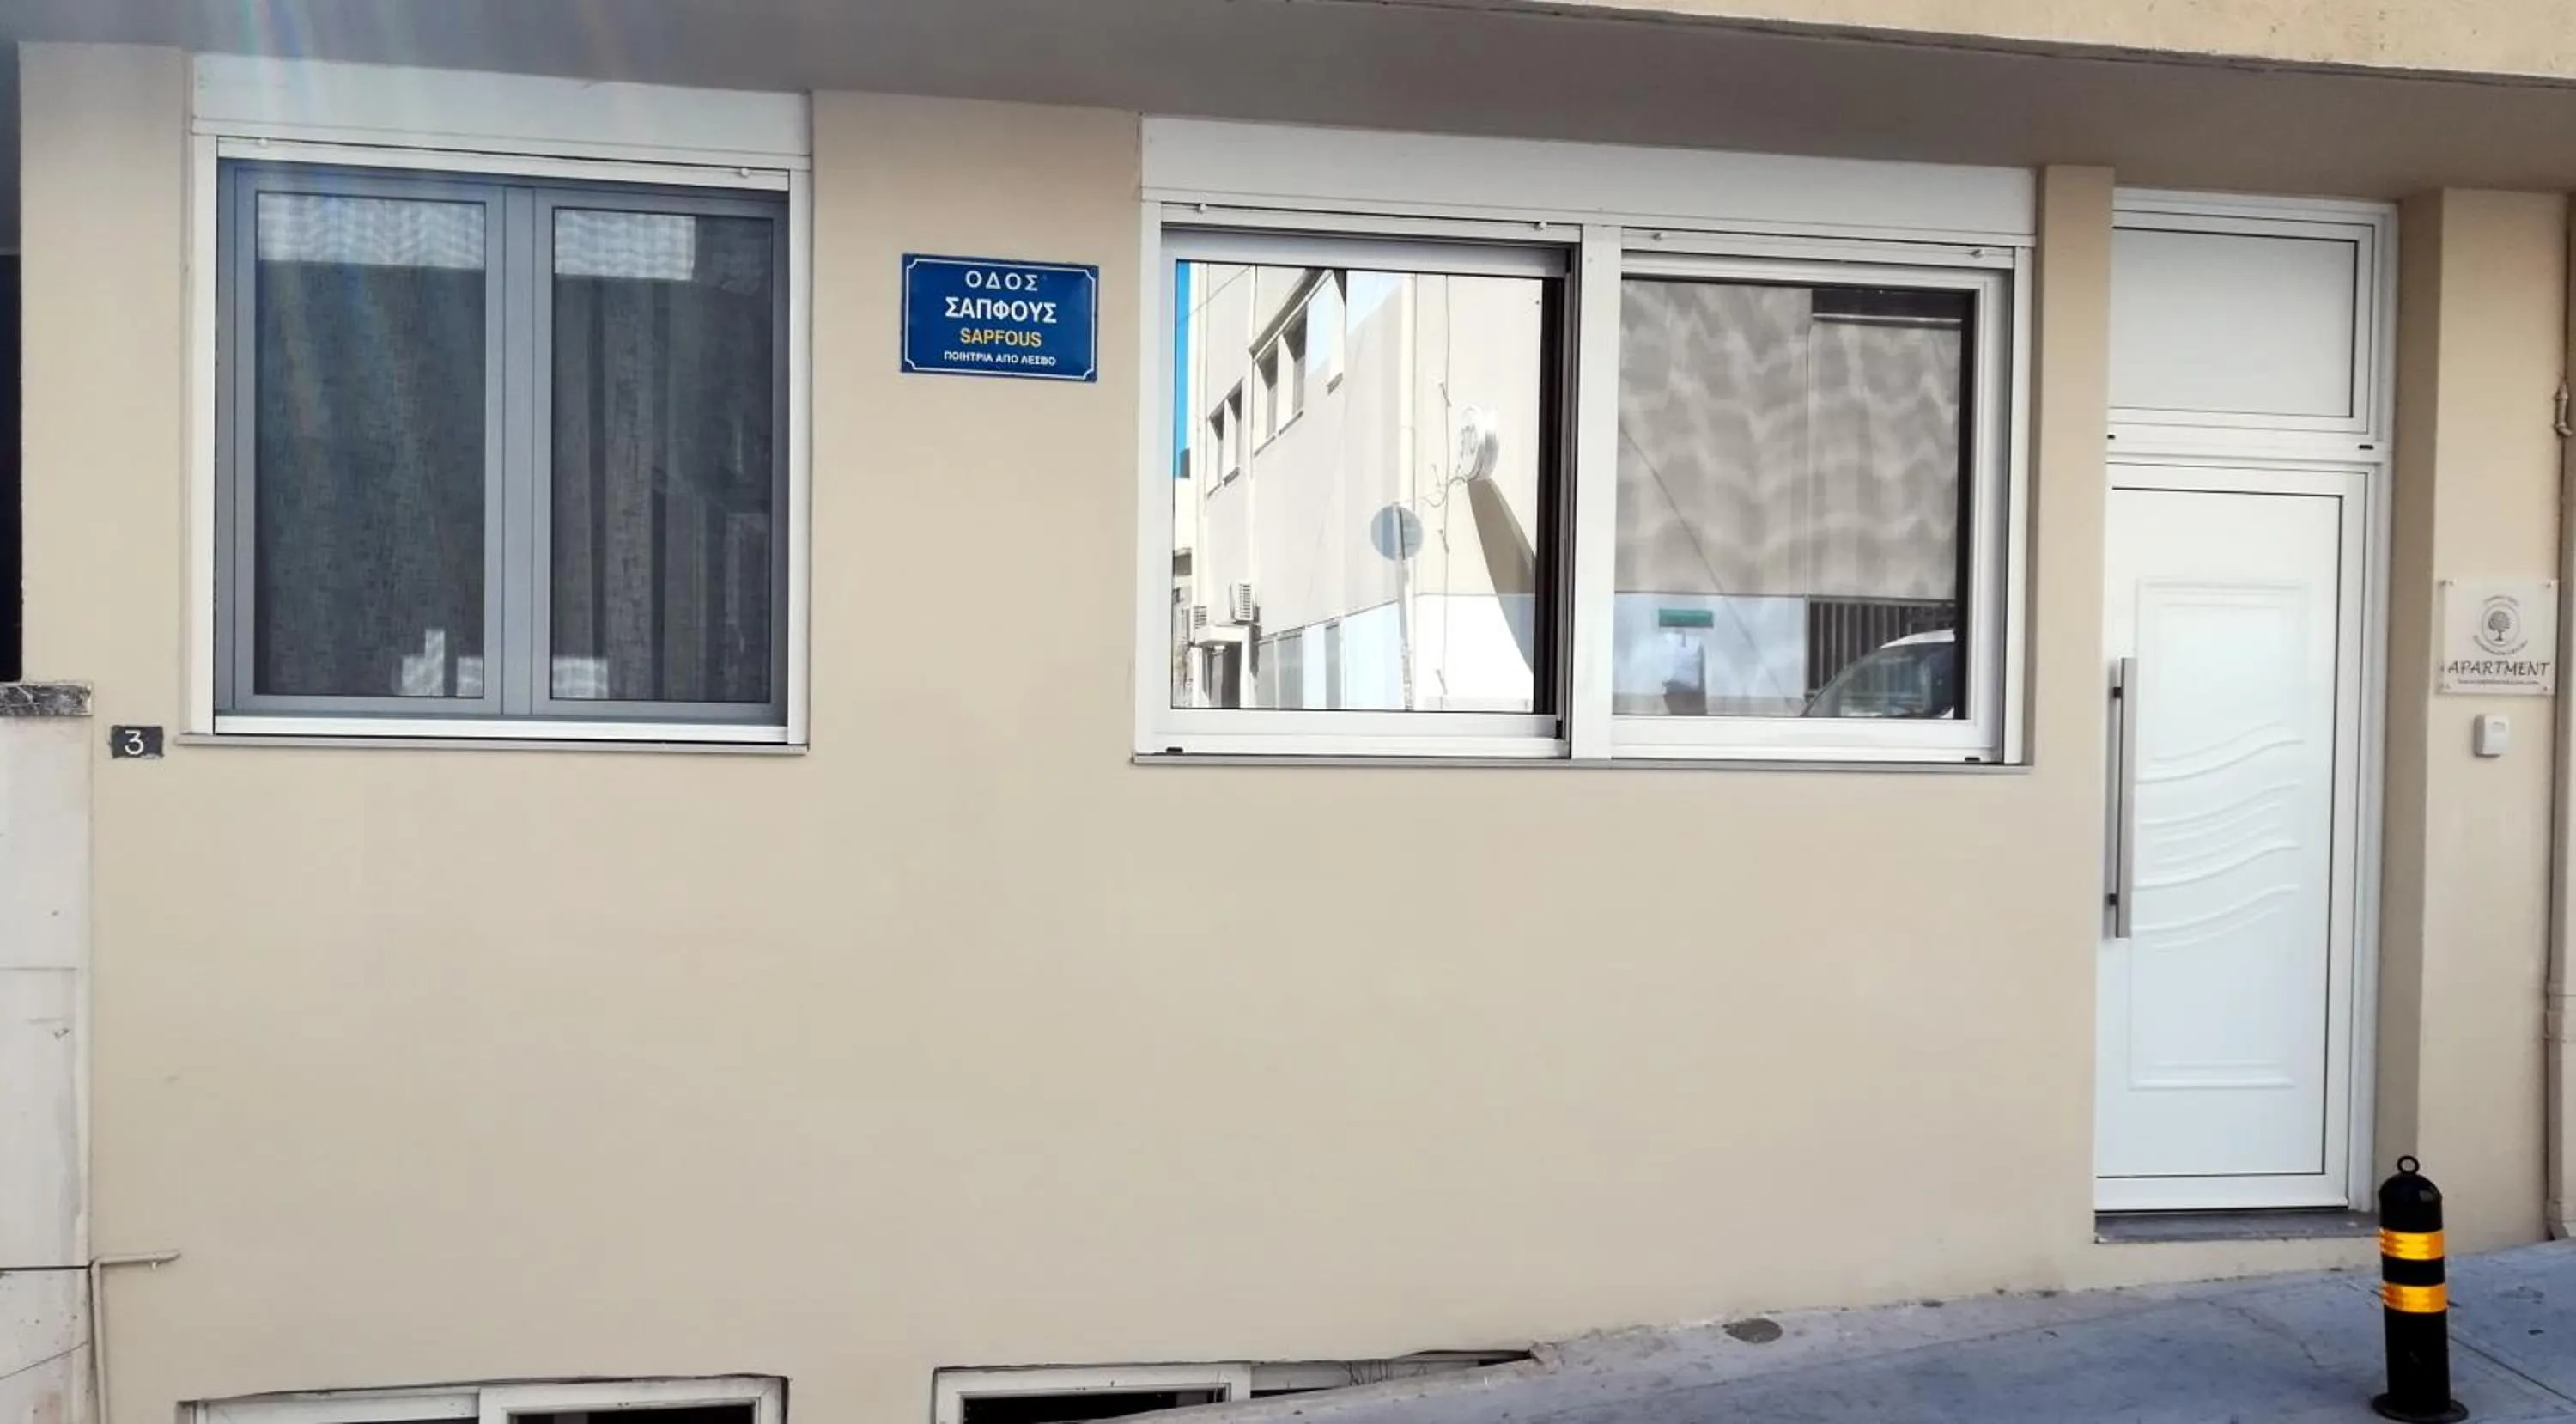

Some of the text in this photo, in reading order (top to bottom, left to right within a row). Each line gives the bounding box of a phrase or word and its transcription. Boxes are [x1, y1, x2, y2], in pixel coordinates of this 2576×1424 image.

[965, 271, 1038, 291] ΟΔΟΣ
[945, 296, 1057, 324] ΣΑΠΦΟΥΣ
[959, 327, 1042, 347] SAPFOUS
[944, 350, 1056, 366] ΠΟΙΗΤΡΙΑ ΑΠΟ ΛΕΣΒΟ
[2447, 660, 2551, 676] APARTMENT
[124, 729, 144, 755] 3
